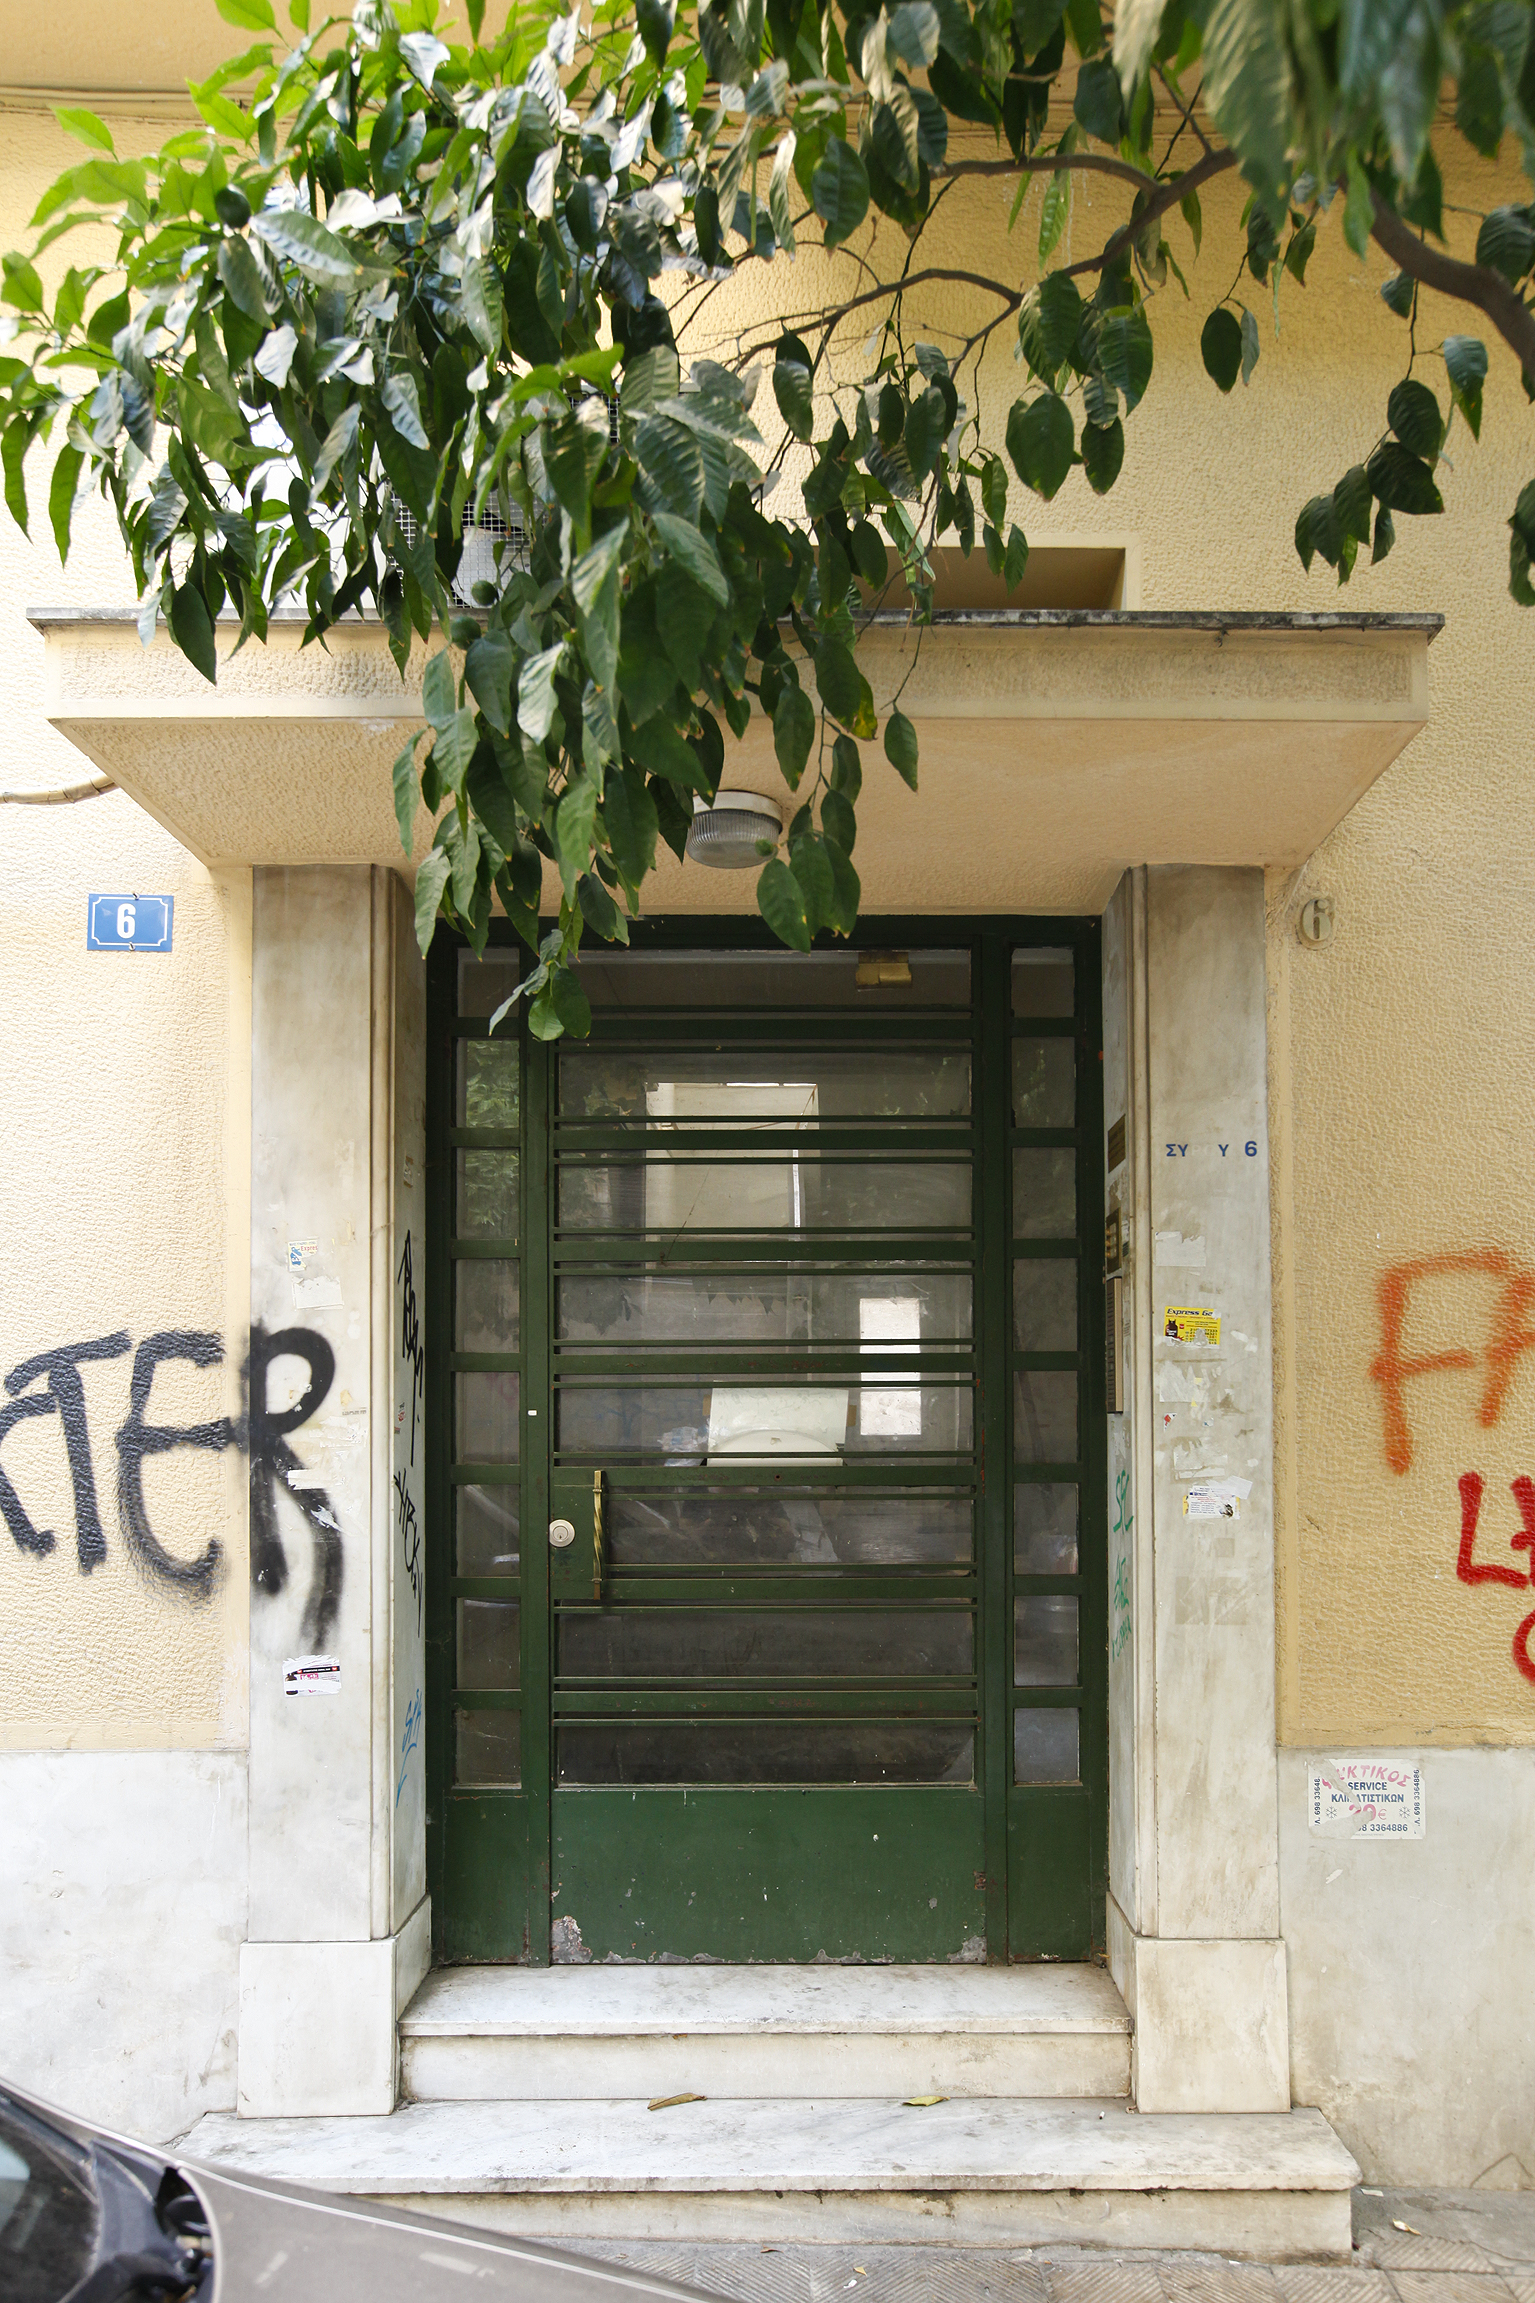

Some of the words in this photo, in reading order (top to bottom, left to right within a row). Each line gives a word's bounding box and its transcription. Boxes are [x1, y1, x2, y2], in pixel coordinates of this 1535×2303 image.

[116, 903, 136, 939] 6
[1302, 899, 1331, 942] 6
[1244, 1140, 1258, 1157] 6
[1348, 1782, 1388, 1790] SERVICE
[1331, 1794, 1404, 1802] ΚΛΙΤΙΣΤΙΚΩΝ
[1370, 1823, 1408, 1831] 3364886
